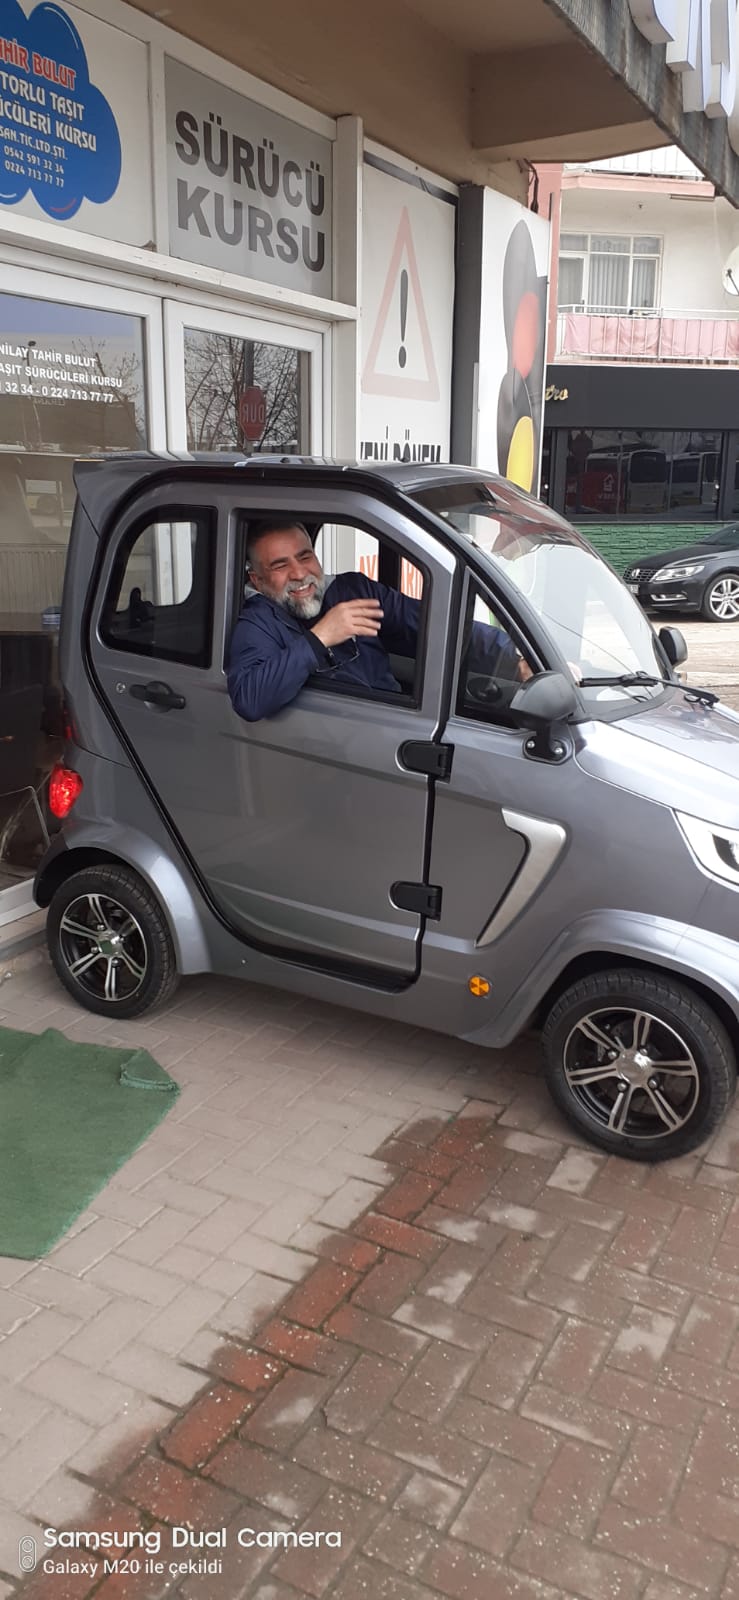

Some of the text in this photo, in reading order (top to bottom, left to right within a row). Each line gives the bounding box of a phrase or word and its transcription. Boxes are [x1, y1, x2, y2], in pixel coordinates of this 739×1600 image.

[32, 51, 76, 91] BULUT
[49, 91, 84, 121] TAŞIT
[55, 120, 96, 152] KURSU
[4, 145, 24, 161] 0542
[26, 153, 41, 166] 591
[43, 159, 53, 170] 32
[5, 160, 25, 175] 0224
[28, 167, 41, 181] 713
[175, 110, 325, 217] SÜRÜCÜ
[176, 178, 325, 272] KURSU
[31, 349, 62, 363] TAHİR
[64, 354, 97, 368] BULUT
[25, 365, 89, 384] SÜRÜCÜLERİ
[91, 375, 123, 388] KURSU
[5, 381, 18, 393] 32
[21, 383, 34, 394] 34
[42, 386, 48, 396] 0
[51, 387, 68, 398] 224
[71, 389, 88, 401] 713
[90, 391, 101, 402] 77
[103, 393, 114, 403] 77
